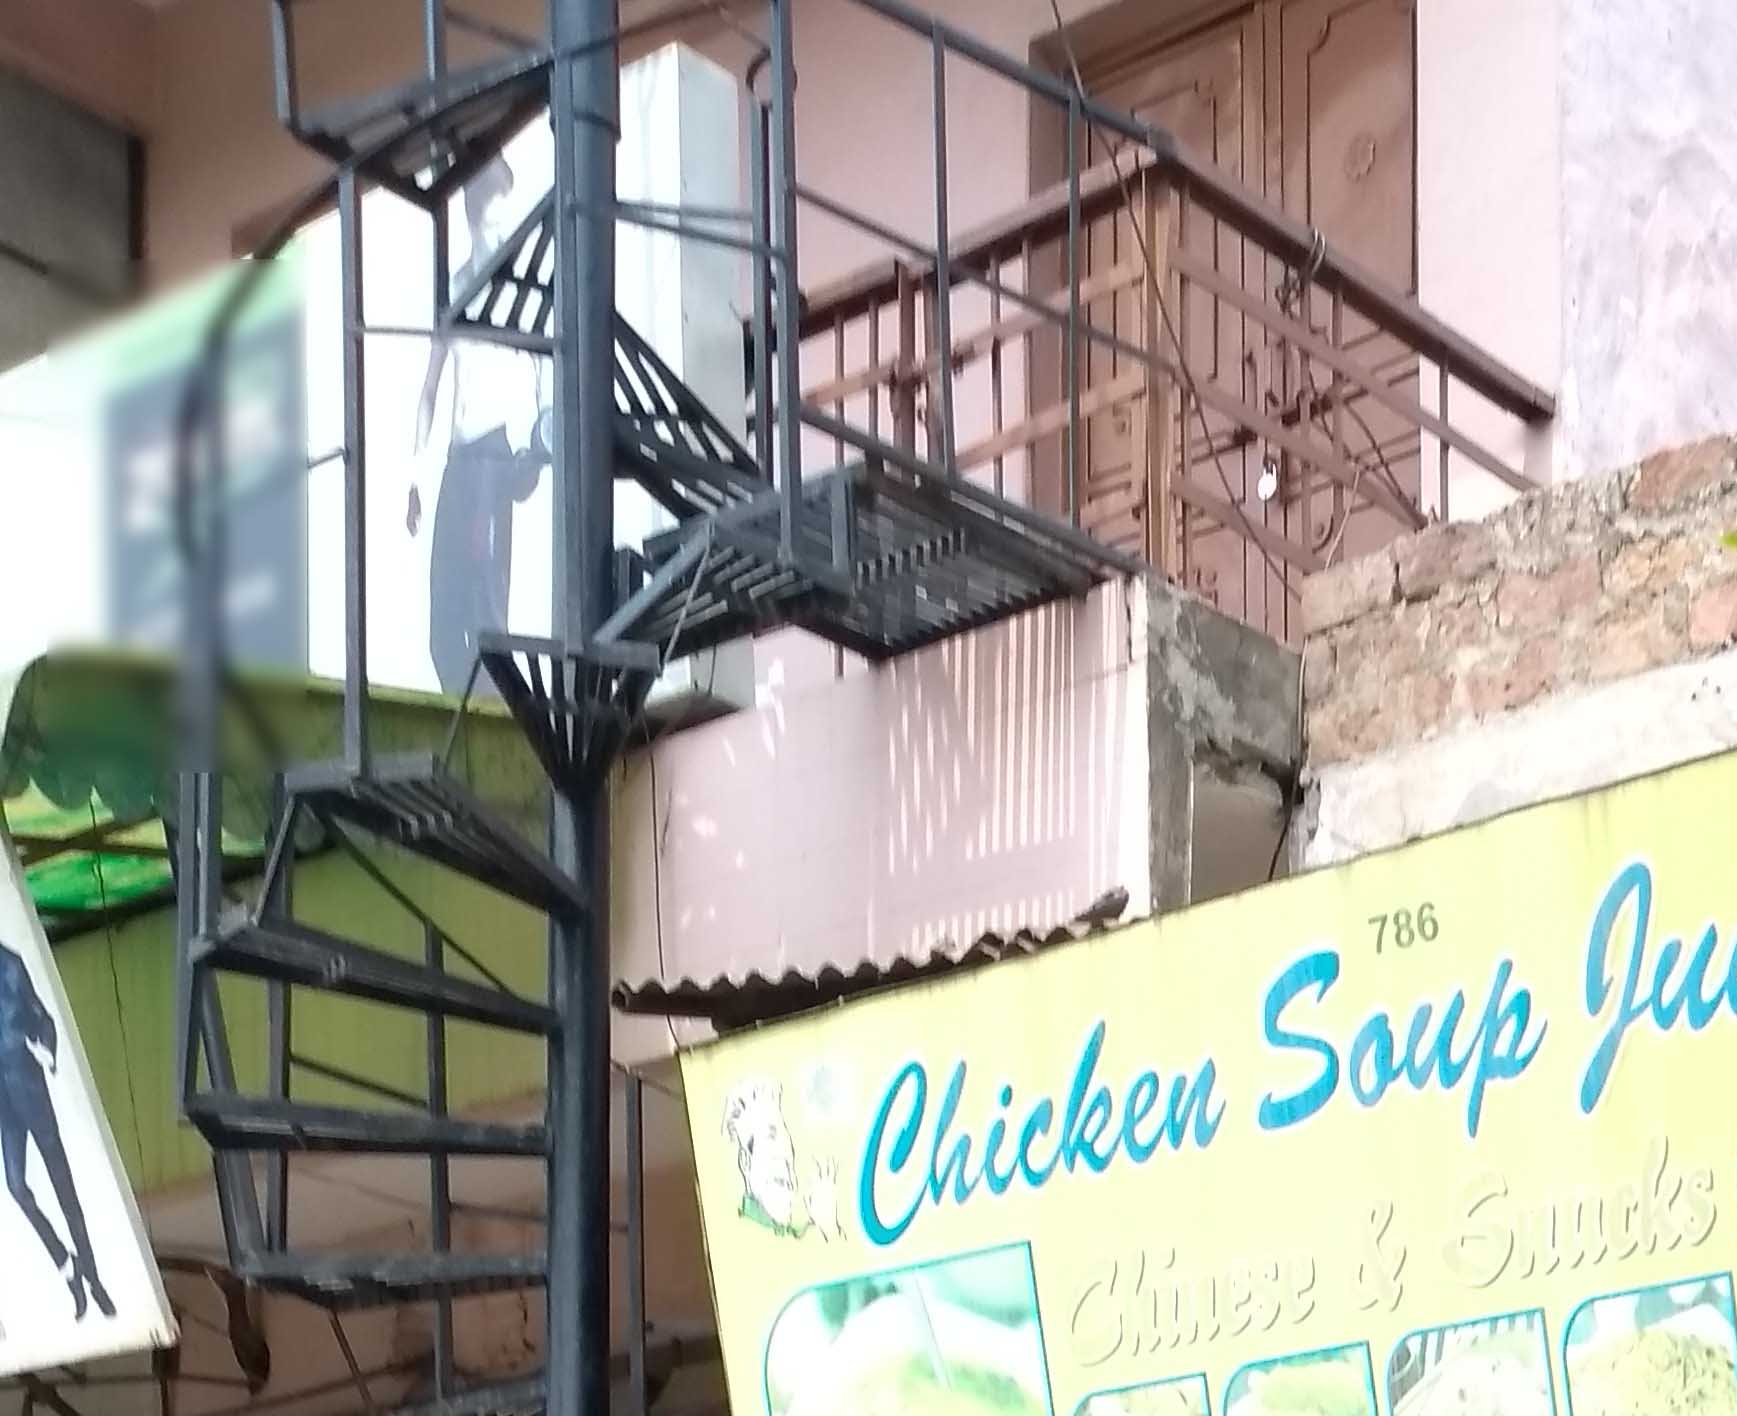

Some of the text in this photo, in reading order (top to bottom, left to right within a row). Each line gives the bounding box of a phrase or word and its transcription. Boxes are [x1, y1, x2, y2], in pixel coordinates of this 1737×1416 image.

[1367, 901, 1440, 955] 786
[858, 1019, 1227, 1246] Chicken
[1257, 949, 1547, 1139] Soup
[1352, 1199, 1408, 1311] &
